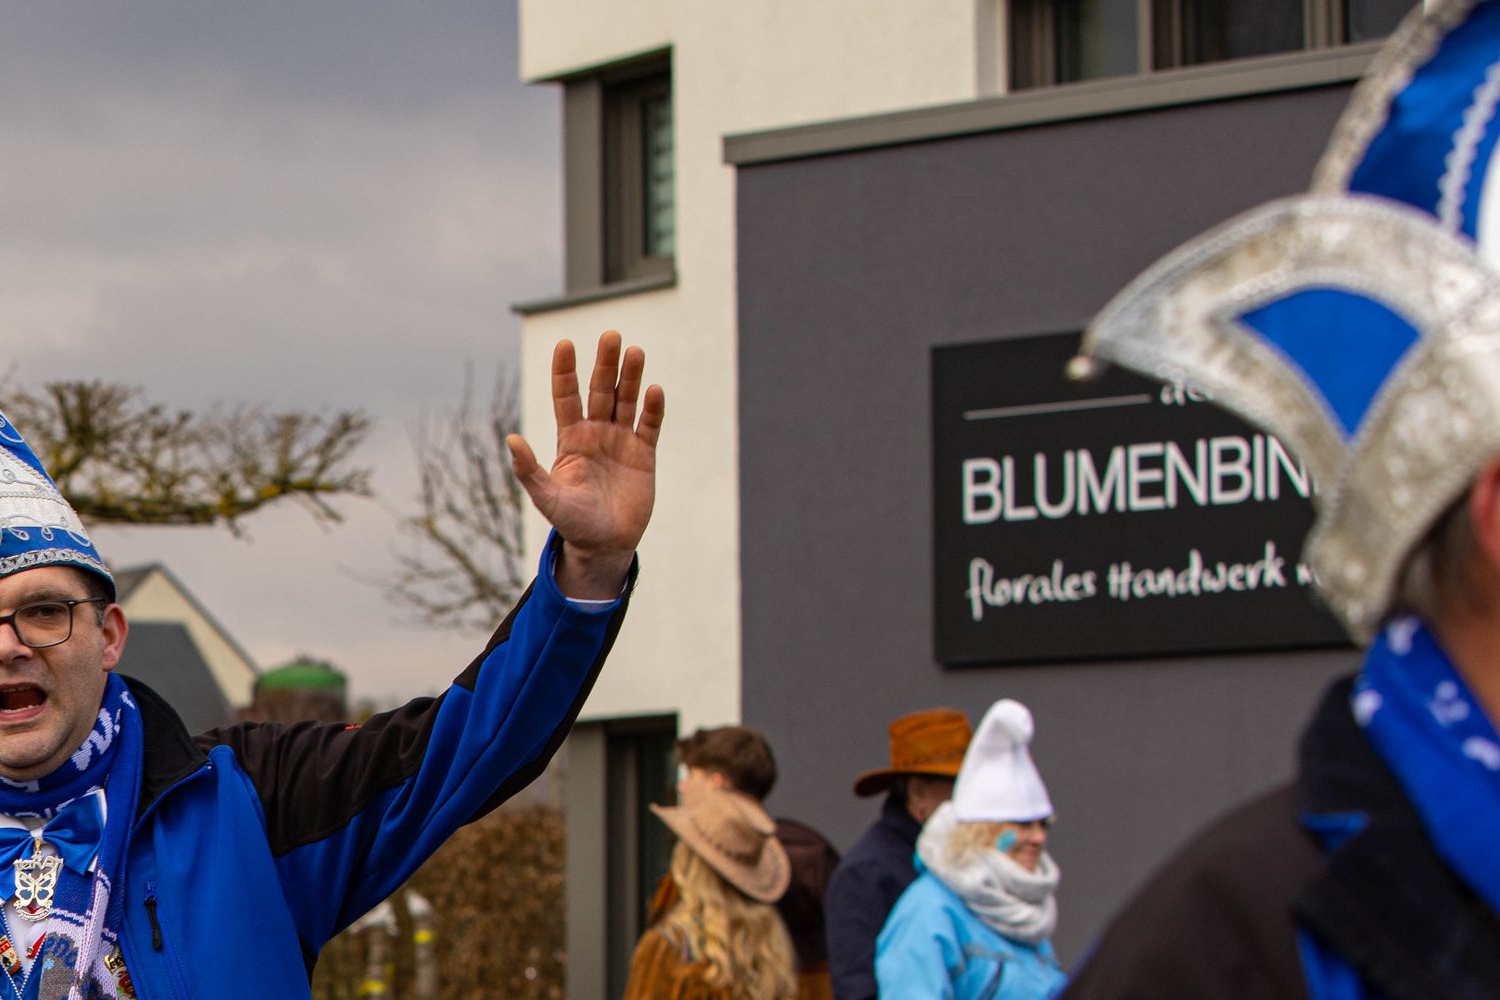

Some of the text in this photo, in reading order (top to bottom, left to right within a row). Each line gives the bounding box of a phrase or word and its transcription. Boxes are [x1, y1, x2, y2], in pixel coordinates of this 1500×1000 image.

[962, 433, 1320, 525] BLUMENBIN
[968, 540, 1288, 622] florales Handwerk
